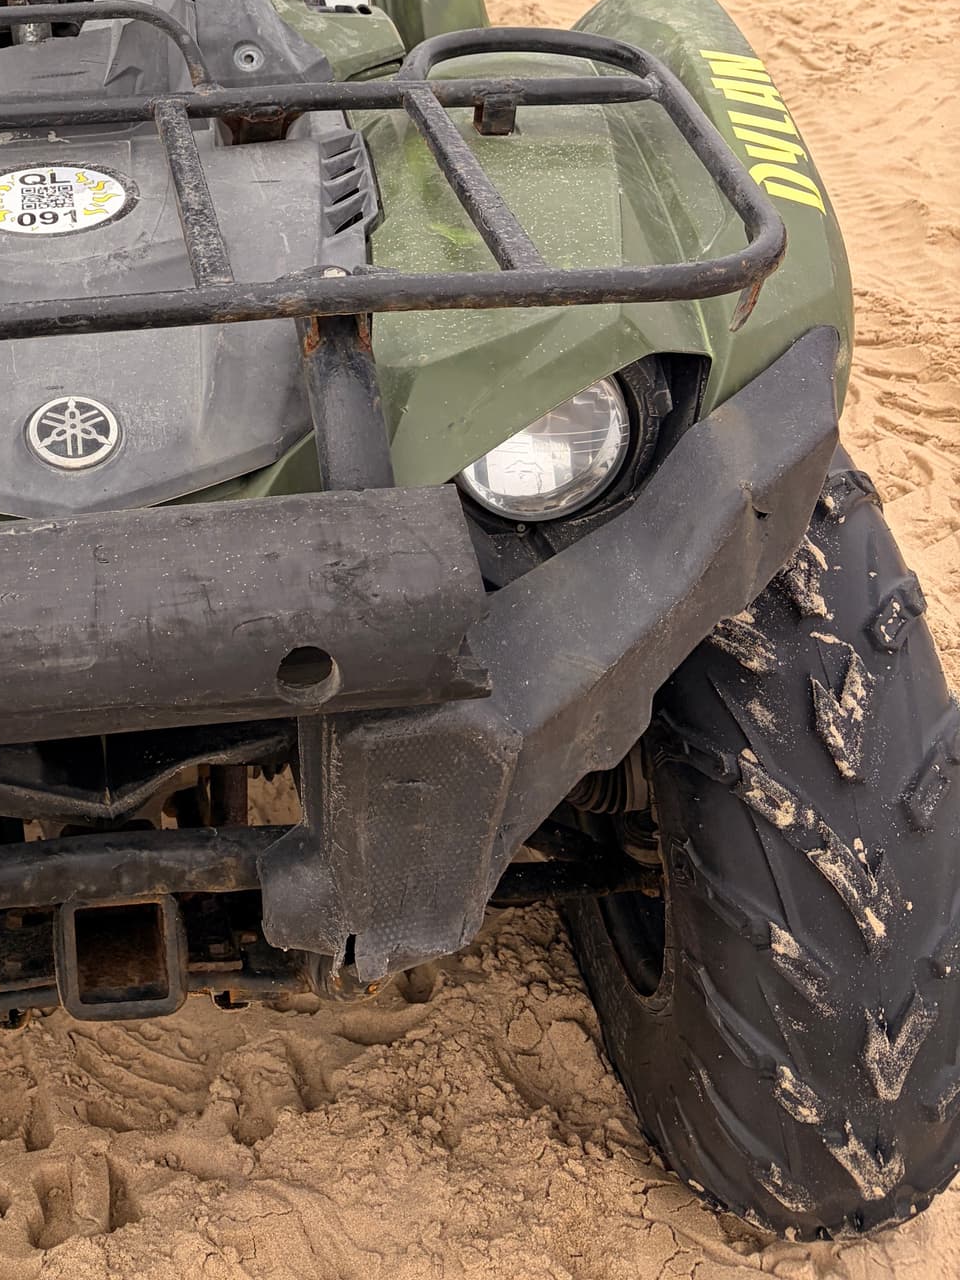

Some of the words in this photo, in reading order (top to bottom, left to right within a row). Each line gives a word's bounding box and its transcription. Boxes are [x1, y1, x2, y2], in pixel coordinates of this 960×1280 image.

[699, 49, 827, 216] DYLAN
[19, 172, 71, 186] QL
[17, 210, 78, 227] 091
